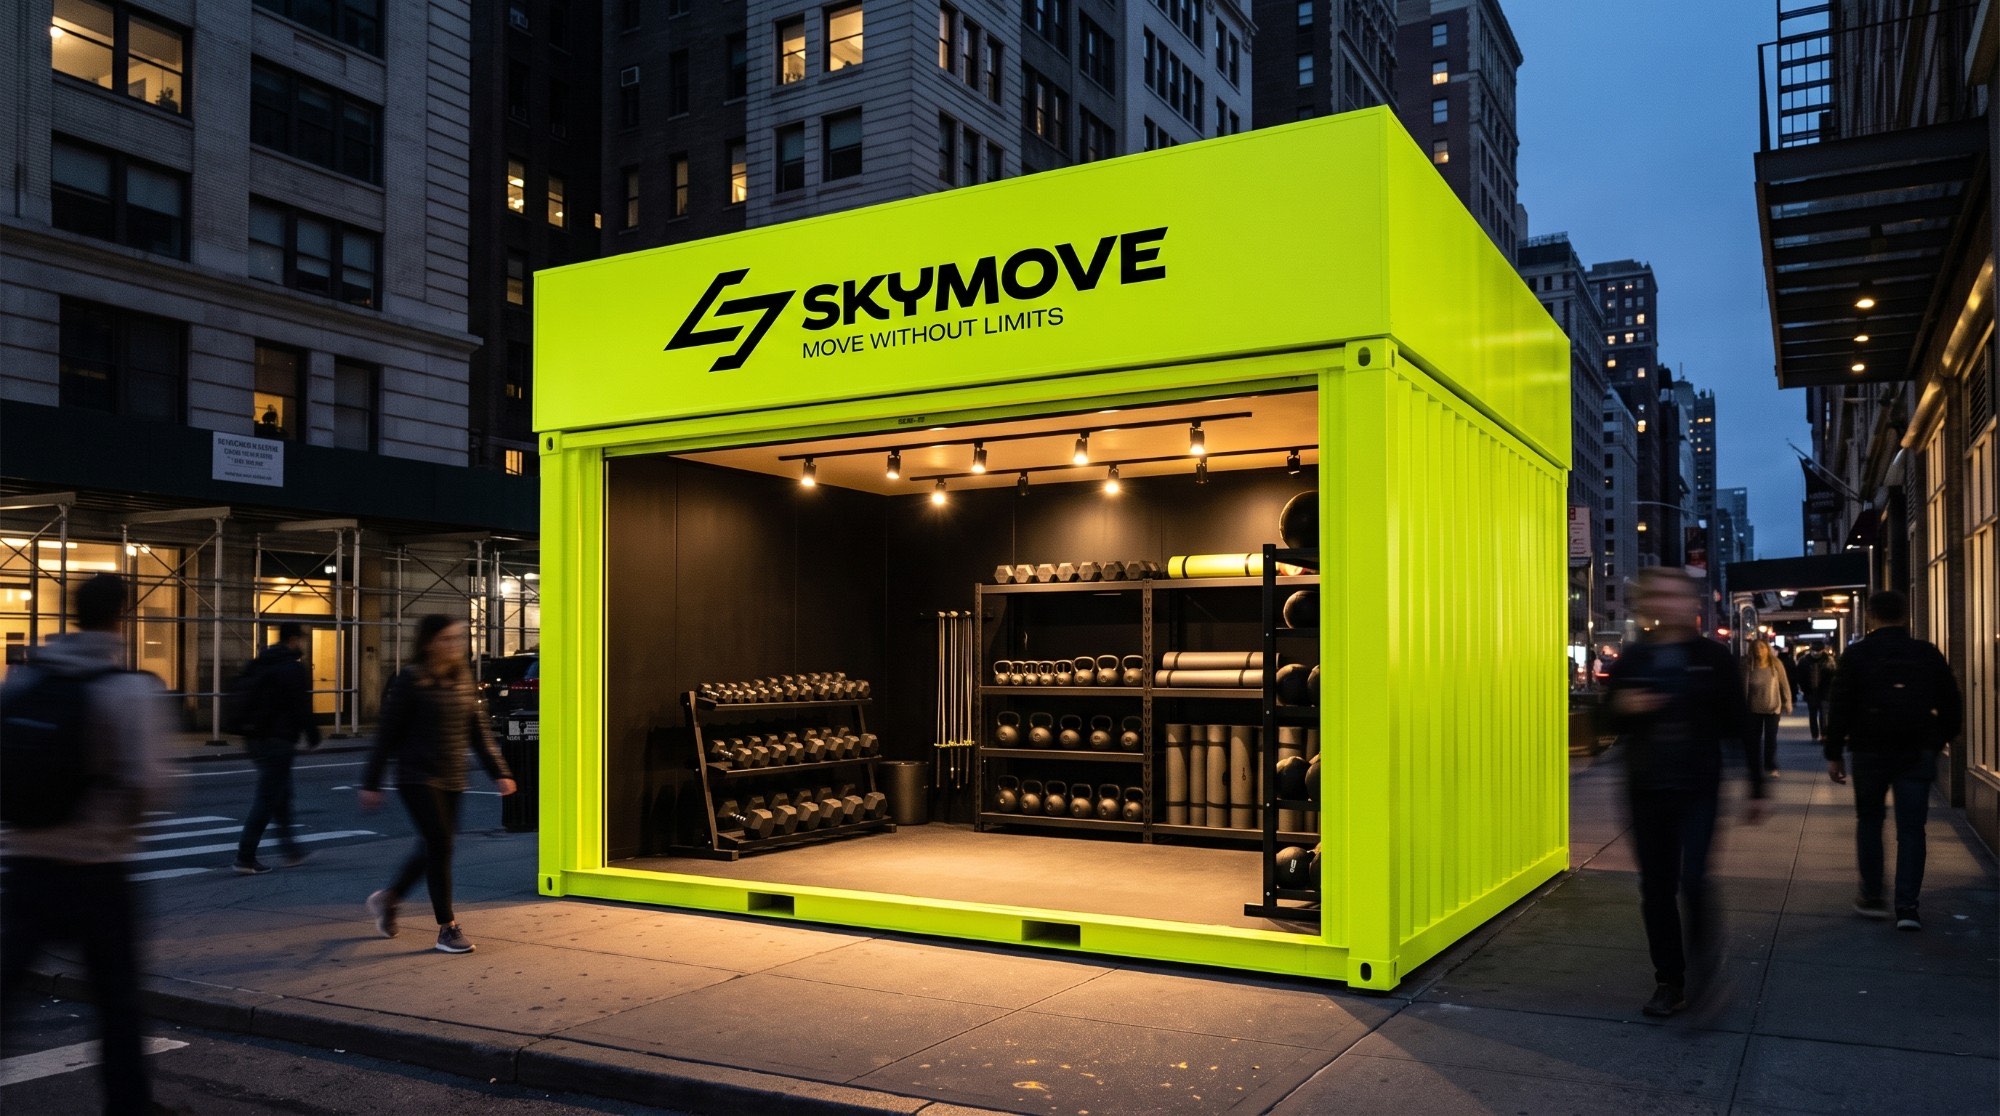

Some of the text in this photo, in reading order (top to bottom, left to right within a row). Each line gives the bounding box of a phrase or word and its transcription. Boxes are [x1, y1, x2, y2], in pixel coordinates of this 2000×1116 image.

[802, 227, 1168, 331] SKYMOVE
[803, 307, 1064, 359] MOVE WITHOUT LIMITS
